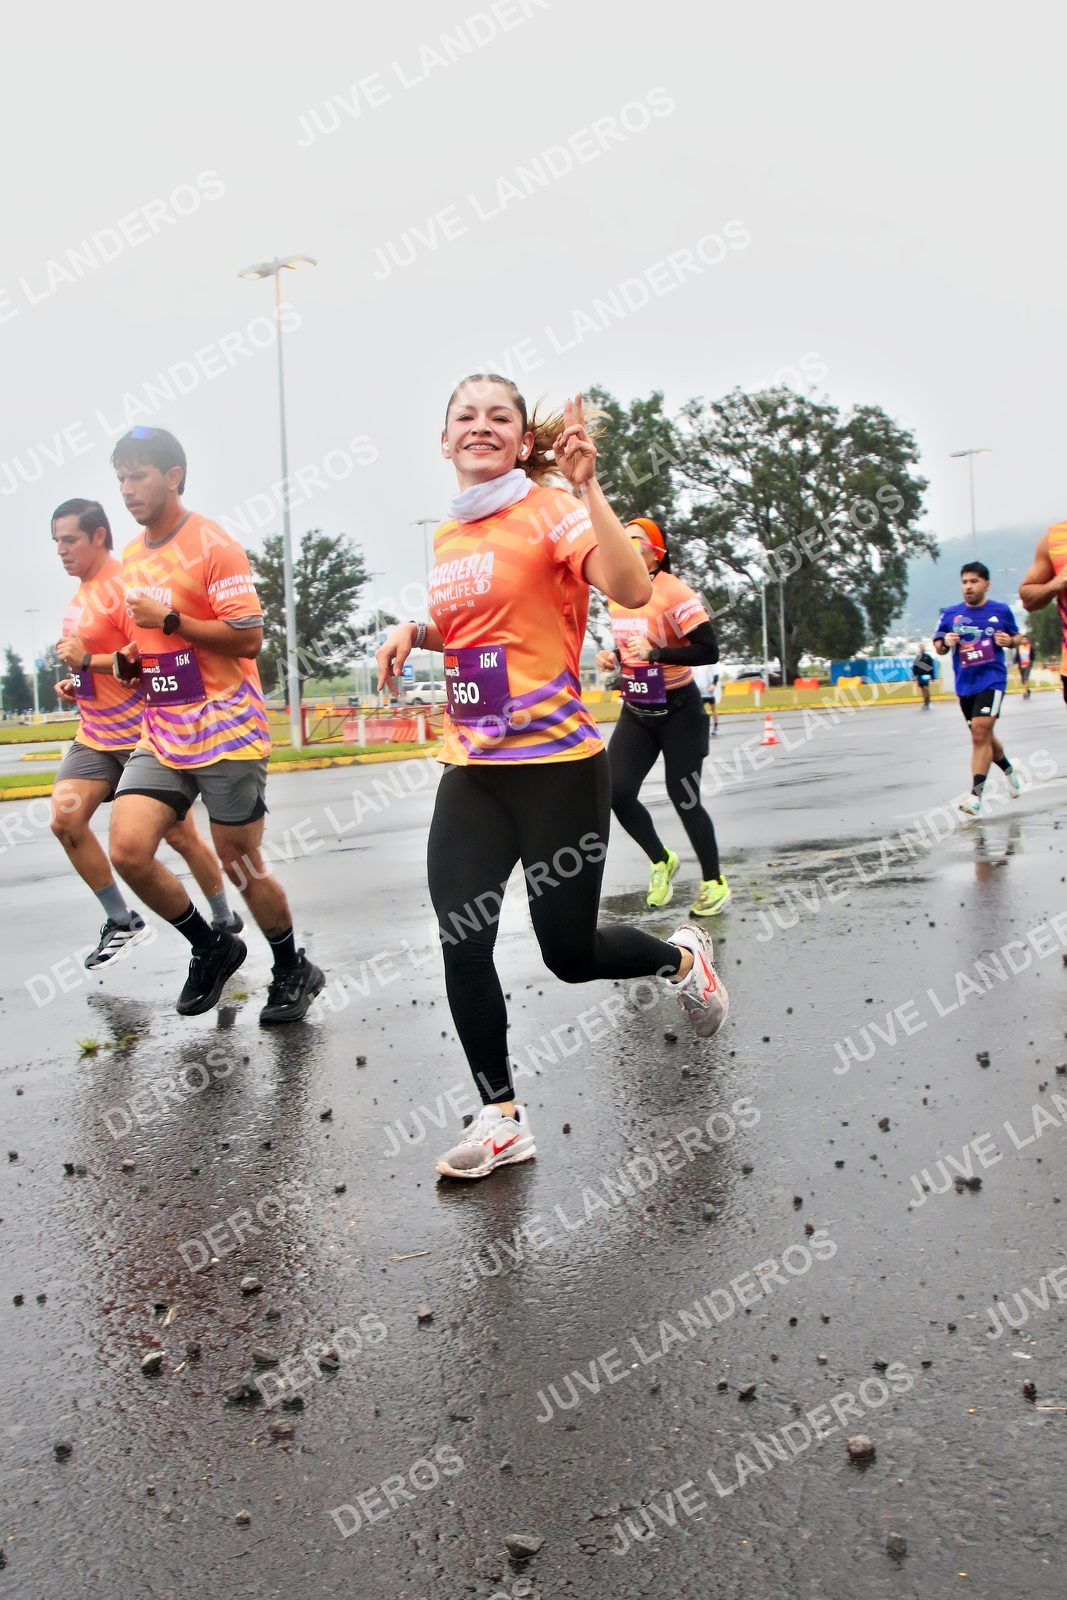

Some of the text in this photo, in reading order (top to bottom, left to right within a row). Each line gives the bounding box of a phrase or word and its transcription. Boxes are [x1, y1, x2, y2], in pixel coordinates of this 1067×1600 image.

[151, 676, 178, 693] 625
[452, 682, 480, 704] 560
[627, 681, 648, 693] 303
